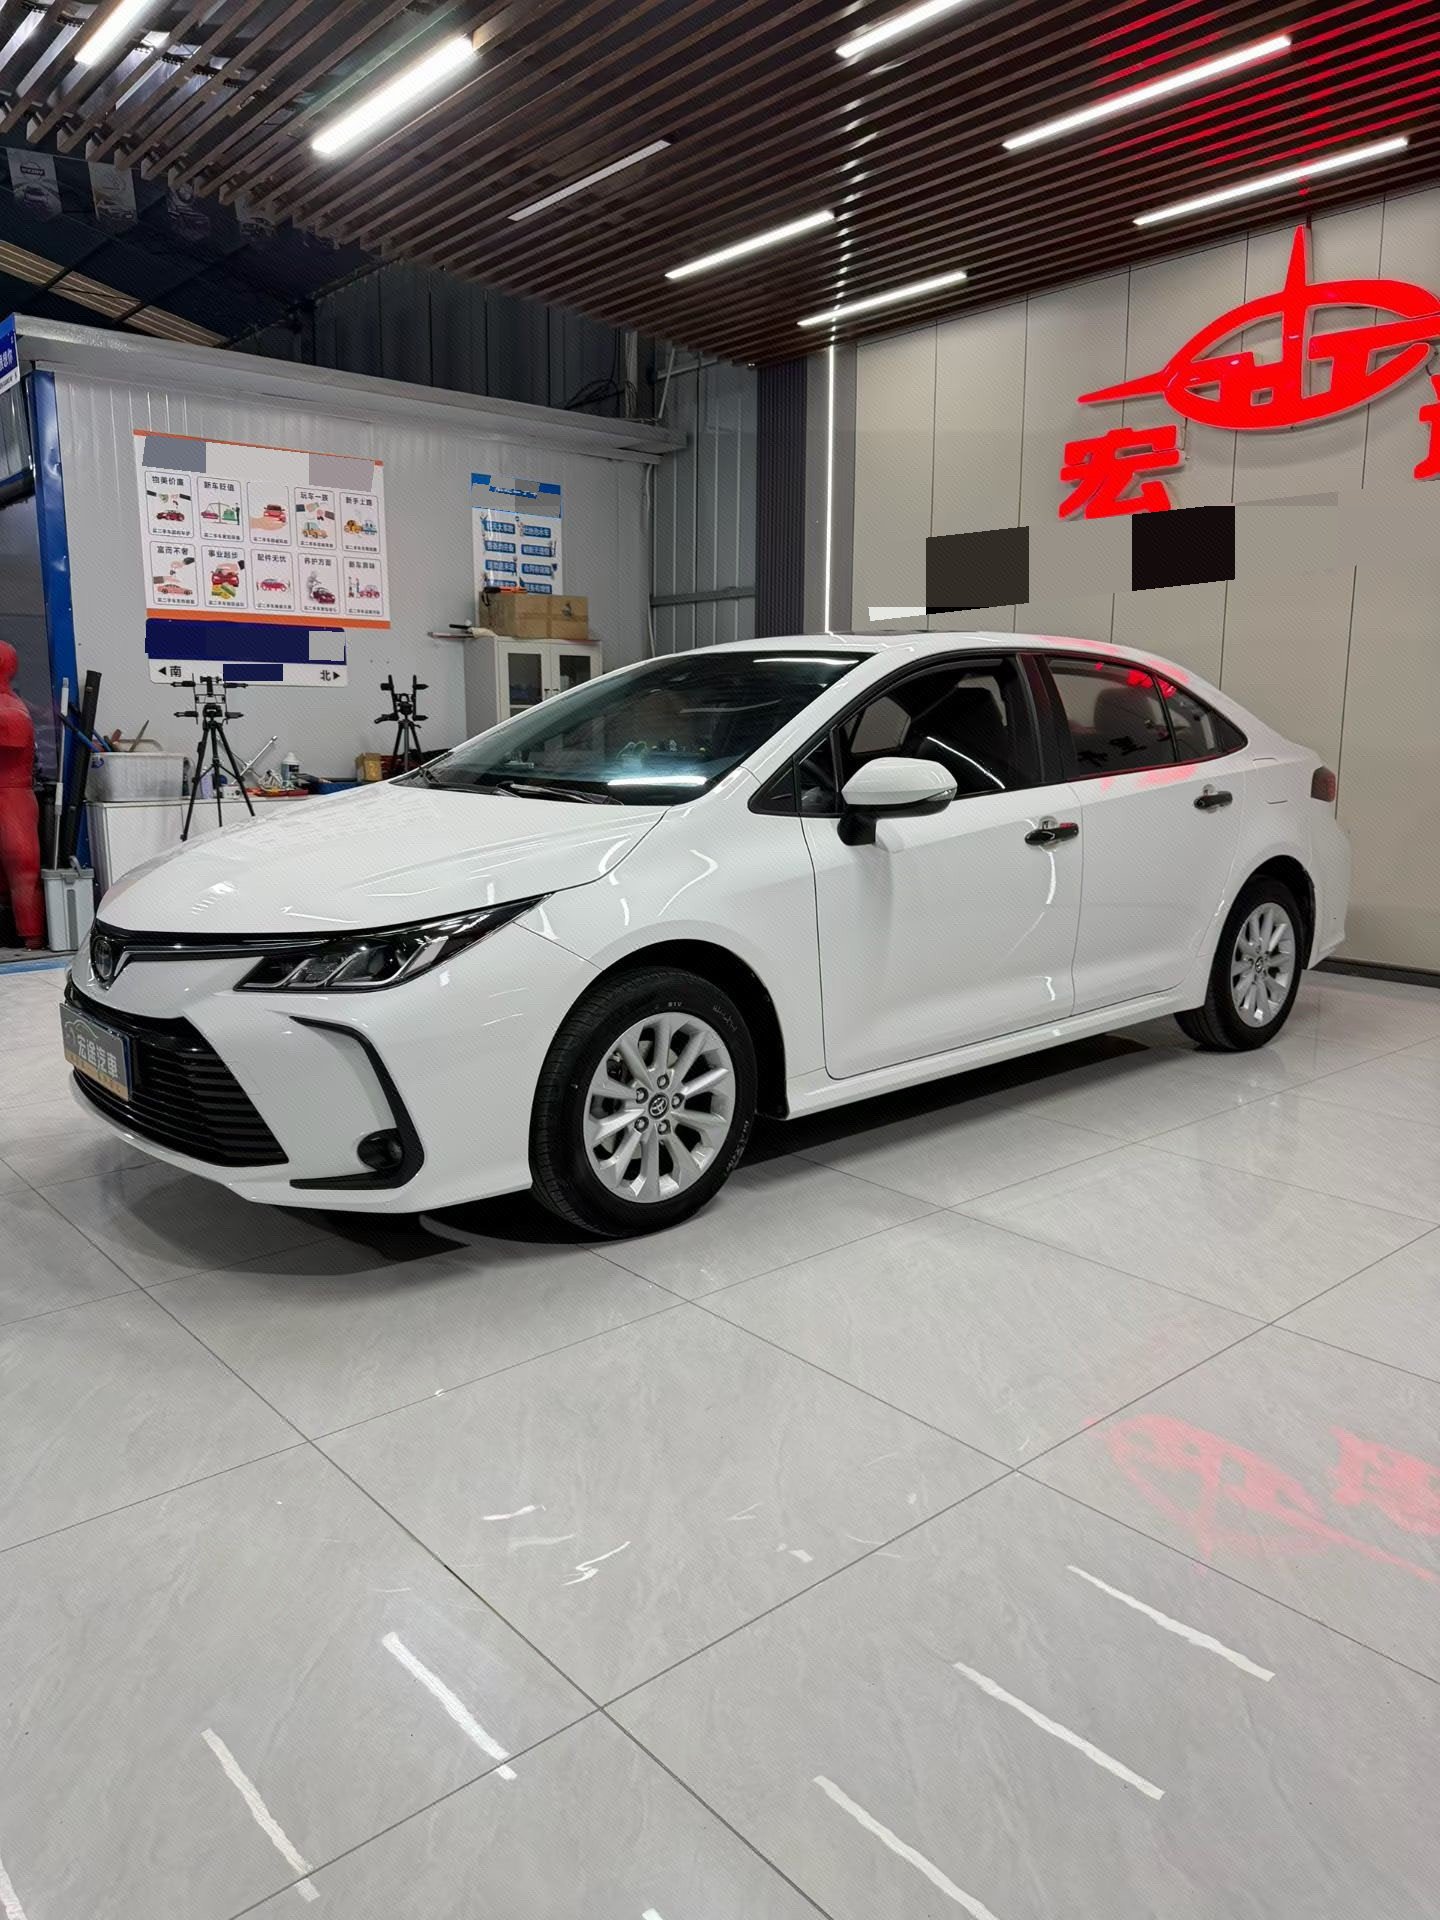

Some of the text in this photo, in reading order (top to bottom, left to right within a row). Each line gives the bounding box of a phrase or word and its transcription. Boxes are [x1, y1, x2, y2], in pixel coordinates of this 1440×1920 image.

[1058, 425, 1183, 520] 宏
[151, 475, 184, 487] 物美价廉
[203, 481, 235, 492] 新车贬值
[300, 492, 329, 502] 玩车一族
[345, 496, 373, 507] 新手上路
[208, 549, 239, 559] 事业起步
[257, 553, 287, 563] 配件无忧
[304, 557, 332, 567] 养护方面
[170, 665, 182, 678] 南
[320, 670, 332, 682] 北
